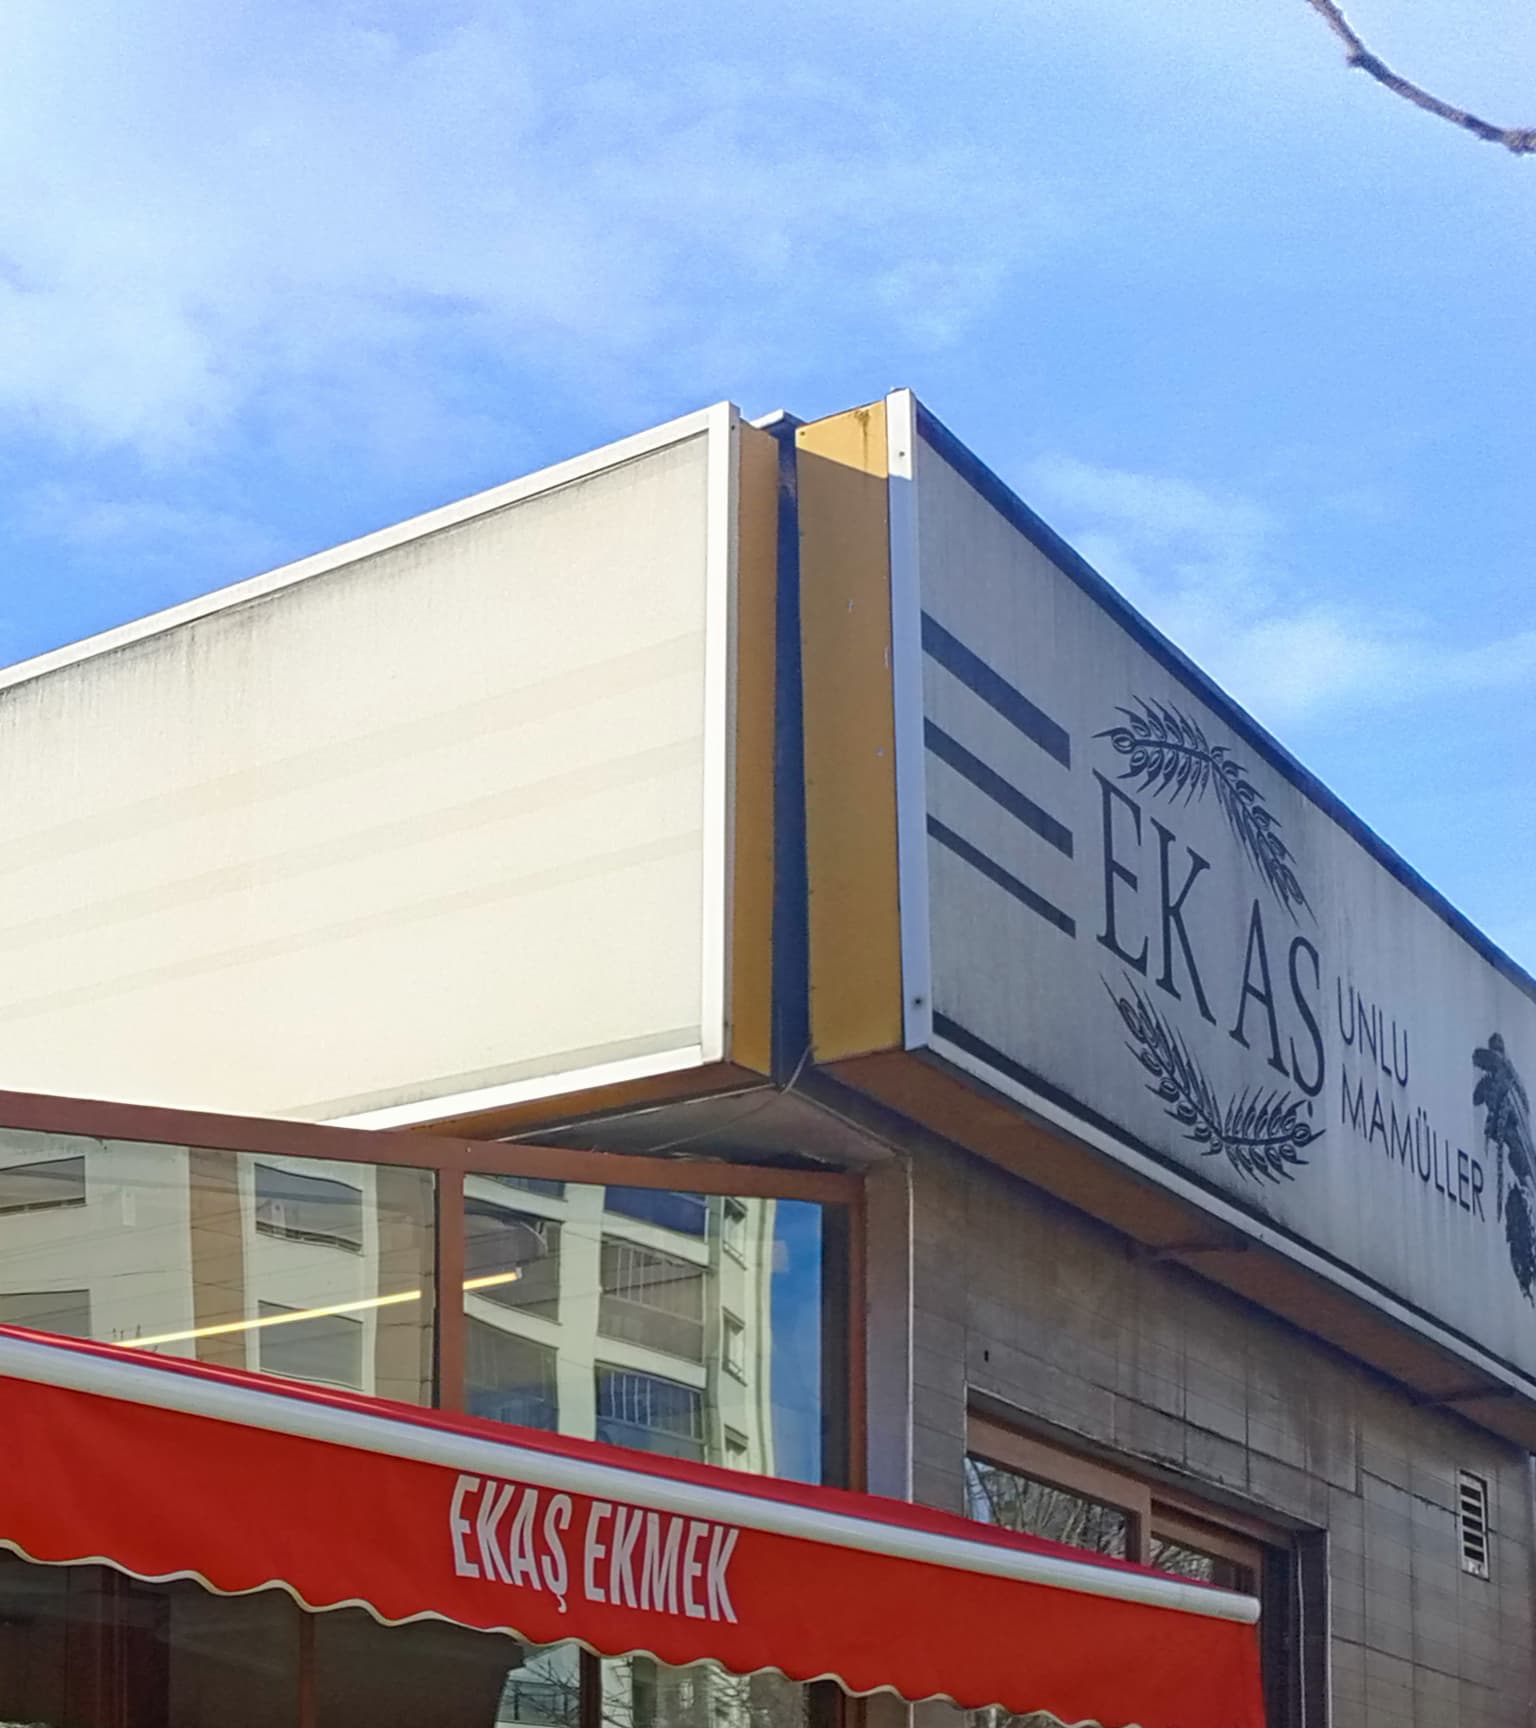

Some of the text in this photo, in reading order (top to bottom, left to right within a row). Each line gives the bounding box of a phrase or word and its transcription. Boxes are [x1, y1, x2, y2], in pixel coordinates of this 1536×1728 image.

[1337, 975, 1409, 1087] UNLU
[1341, 1063, 1486, 1223] MAMÜLLER
[449, 1475, 739, 1624] EKAŞ EKMEK
